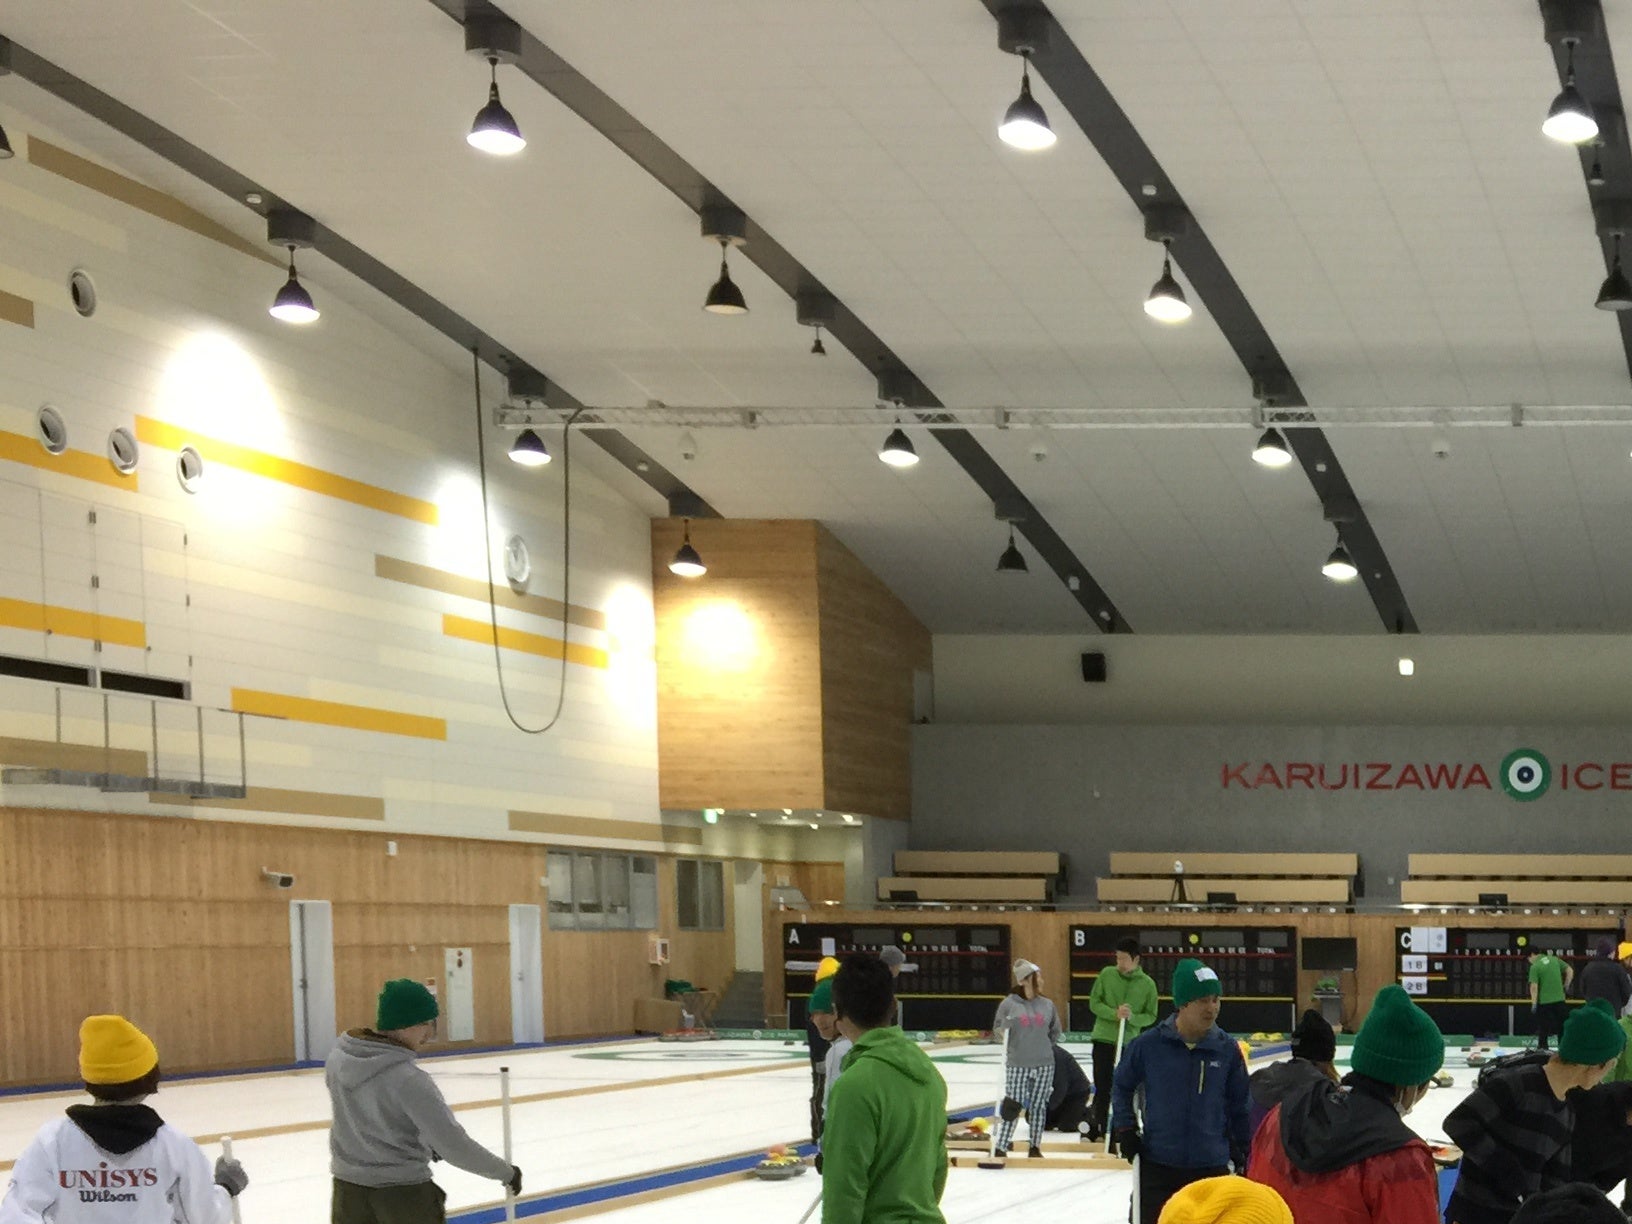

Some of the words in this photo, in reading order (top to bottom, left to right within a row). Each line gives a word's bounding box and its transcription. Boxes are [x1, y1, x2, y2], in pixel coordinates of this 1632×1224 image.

[1221, 763, 1492, 791] KARUIZAWA
[788, 928, 800, 945] A
[1074, 929, 1086, 948] B
[1401, 932, 1412, 949] C
[79, 1189, 138, 1203] Wilson
